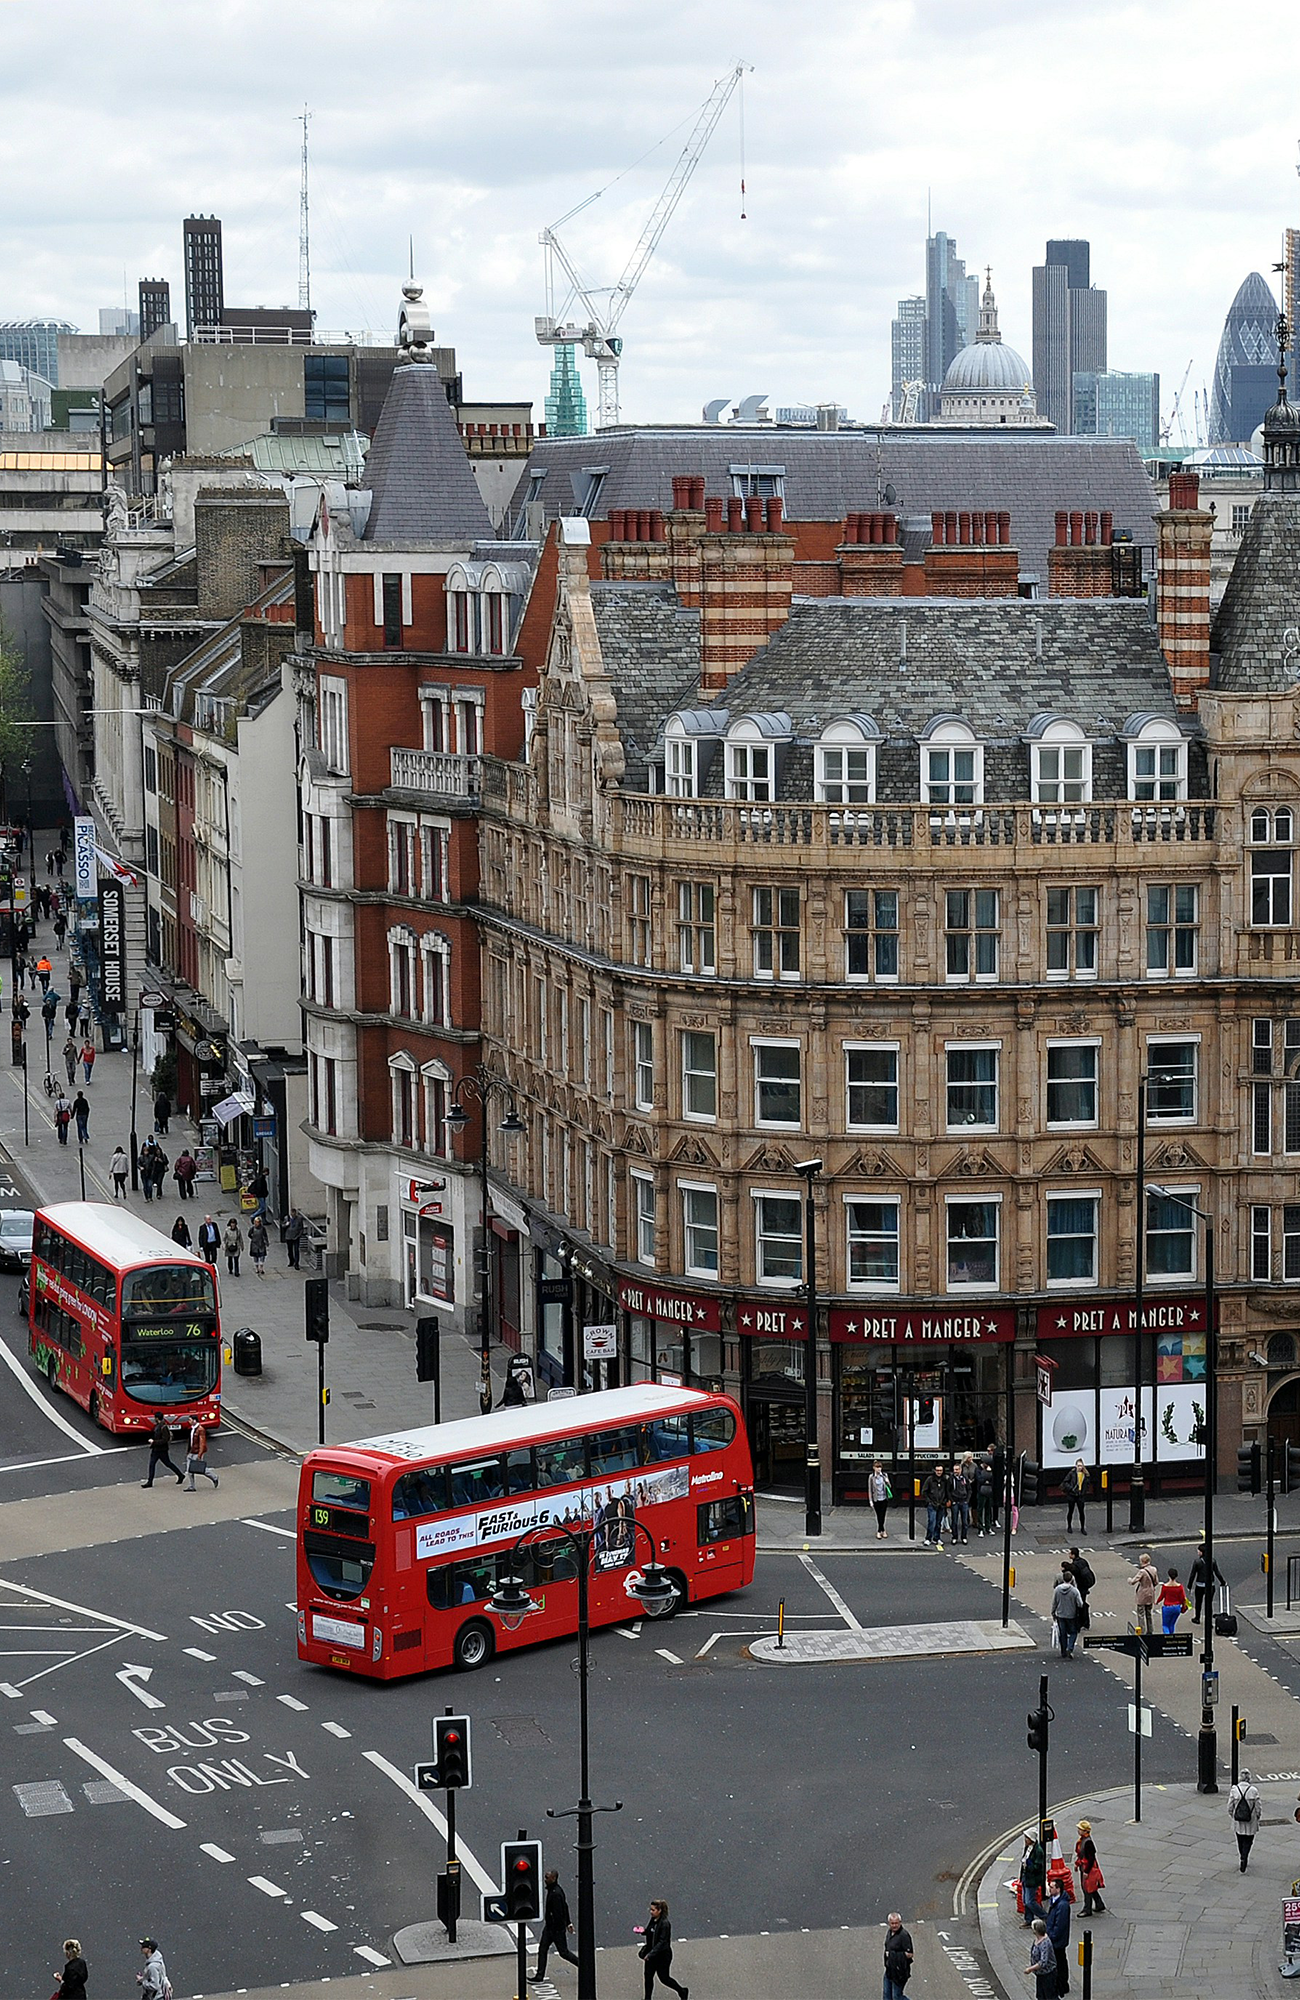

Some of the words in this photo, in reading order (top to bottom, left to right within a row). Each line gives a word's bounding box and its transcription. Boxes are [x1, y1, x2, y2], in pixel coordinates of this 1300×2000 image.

[77, 825, 90, 880] PICASSO
[103, 890, 120, 956] SOMERSET
[104, 961, 121, 1002] HOUSE
[542, 1284, 569, 1294] RUSH
[627, 1288, 644, 1311] PRET
[646, 1296, 653, 1314] A
[656, 1296, 694, 1322] MANGER
[137, 1327, 175, 1337] Waterloo
[186, 1323, 201, 1337] 76
[756, 1310, 787, 1333] PRET
[863, 1317, 897, 1339] PRET
[904, 1318, 914, 1339] A
[921, 1316, 981, 1339] MANGER
[1073, 1310, 1105, 1332] PRET
[1112, 1311, 1121, 1330] A
[1128, 1306, 1184, 1329] MANGER
[585, 1328, 614, 1341] CROWN
[1105, 1429, 1128, 1440] NATURA
[690, 1471, 724, 1486] Metroline
[315, 1508, 329, 1525] 139
[478, 1511, 514, 1531] FAST
[481, 1515, 538, 1541] FURIOUS
[539, 1509, 550, 1524] 6
[419, 1533, 432, 1543] ALL
[434, 1527, 461, 1539] ROADS
[426, 1538, 446, 1548] LEAD
[447, 1536, 457, 1544] TO
[458, 1530, 475, 1541] THIS
[188, 1610, 267, 1634] NO
[131, 1718, 251, 1753] BUS
[166, 1751, 310, 1794] ONLY
[1255, 1771, 1300, 1781] LOOK
[942, 1946, 981, 1971] RIGHT
[531, 1977, 562, 2000] OOK
